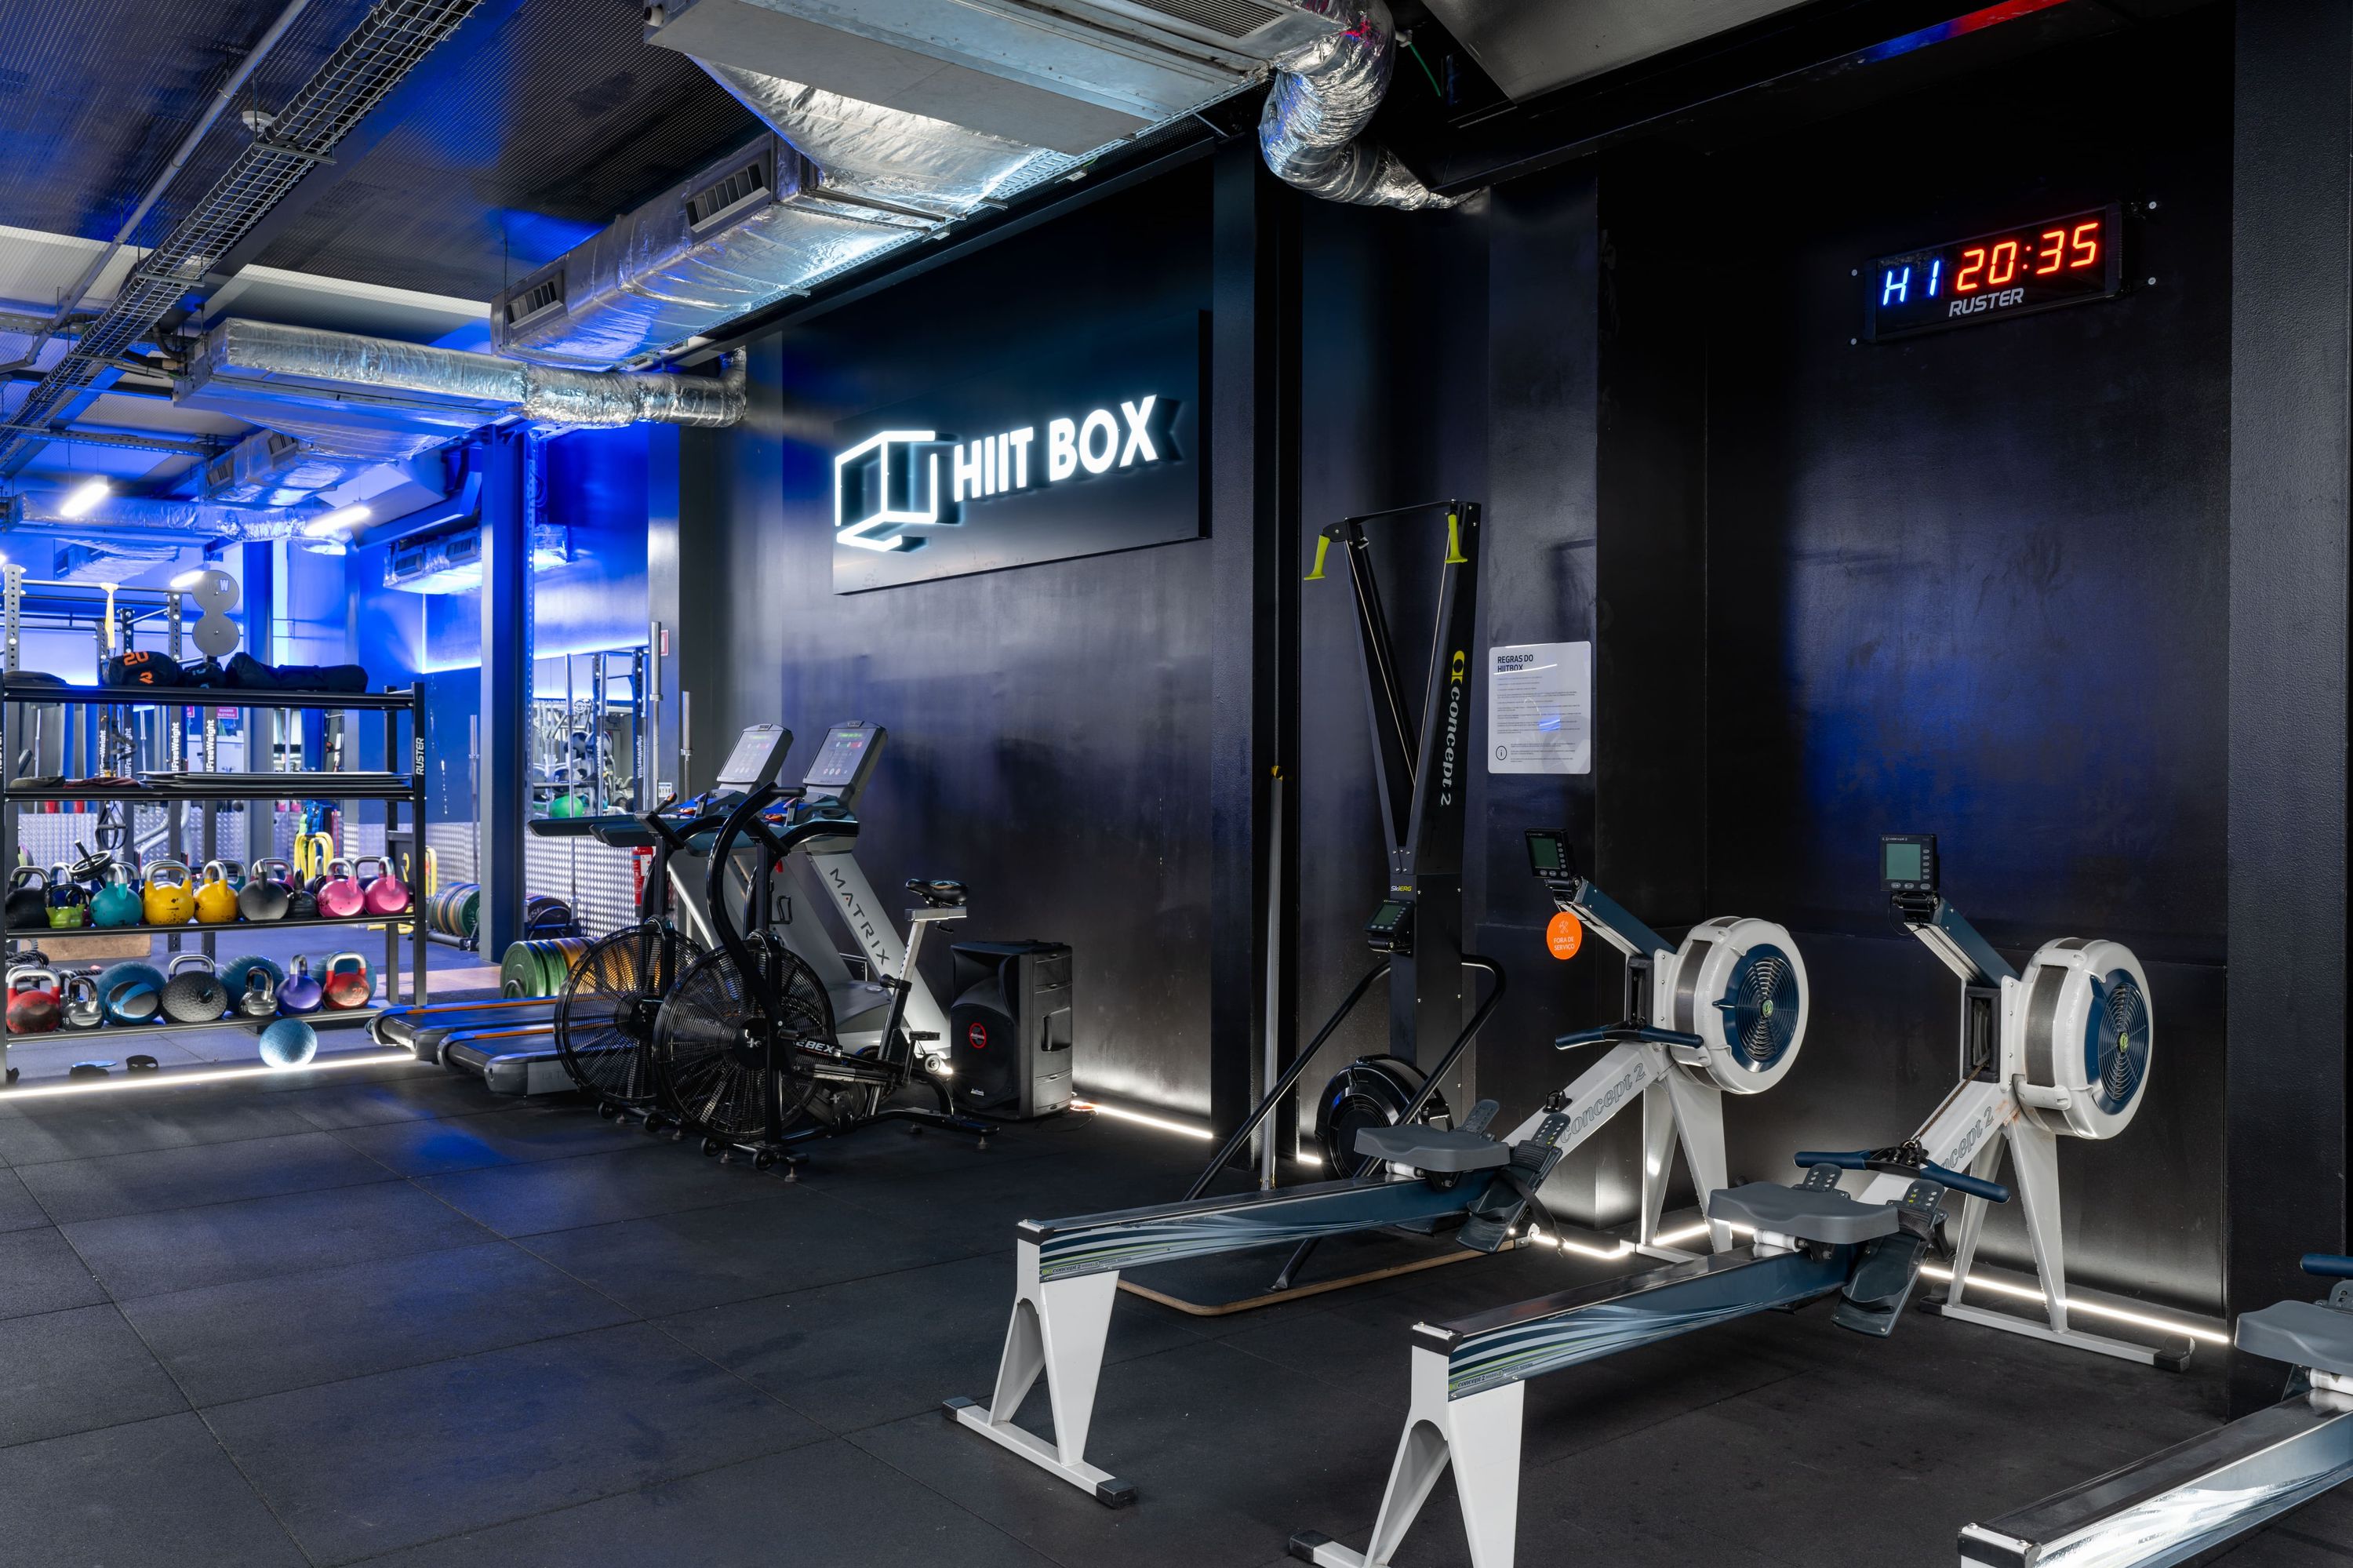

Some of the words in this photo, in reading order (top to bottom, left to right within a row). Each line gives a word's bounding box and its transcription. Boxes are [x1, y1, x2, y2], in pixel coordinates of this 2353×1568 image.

[1956, 223, 2099, 291] 20:35
[1948, 287, 2024, 317] RUSTER
[954, 427, 1034, 502] HIIT
[1049, 395, 1159, 482] BOX
[1497, 655, 1523, 664] REGRAS
[1497, 664, 1523, 672] HIITBOX
[172, 722, 180, 772] lFreeWeight
[205, 719, 216, 772] lFreeWeight
[416, 737, 424, 775] RUSTER
[1442, 686, 1460, 788] concept
[1441, 792, 1451, 806] 2
[829, 868, 890, 966] MATRIX
[1560, 1074, 1633, 1144] concept
[1633, 1062, 1646, 1082] 2
[1940, 1119, 1984, 1170] ncept
[1984, 1106, 1995, 1129] 2
